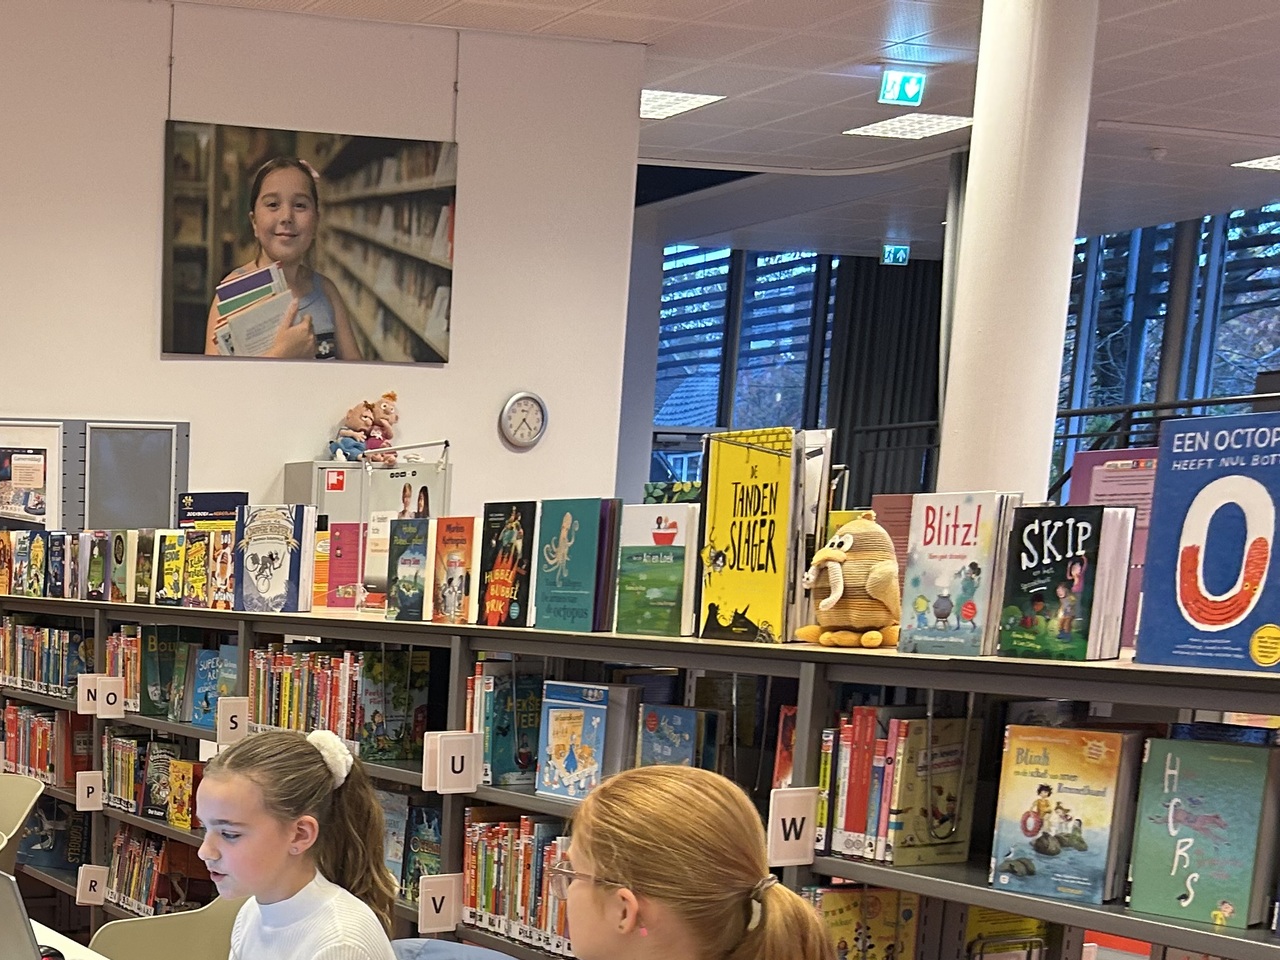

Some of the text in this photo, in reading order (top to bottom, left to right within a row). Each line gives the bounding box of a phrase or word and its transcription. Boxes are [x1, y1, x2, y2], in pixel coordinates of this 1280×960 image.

[1173, 430, 1210, 453] EEN
[750, 465, 758, 479] DE
[1171, 458, 1216, 471] HEEFT
[1220, 455, 1247, 467] NUL
[731, 482, 779, 518] TANDEN
[923, 505, 982, 546] Blitz!
[728, 519, 777, 574] SLAGER
[1021, 518, 1092, 571] SKIP
[484, 568, 514, 584] HUBBEL
[490, 581, 519, 600] BUBBEL
[485, 598, 506, 614] PRIK
[87, 689, 97, 701] N
[106, 692, 117, 706] O
[229, 714, 238, 730] S
[451, 755, 465, 775] U
[86, 786, 95, 799] P
[781, 816, 806, 841] W
[68, 825, 84, 864] GORGELS
[89, 880, 98, 893] R
[432, 896, 446, 914] V
